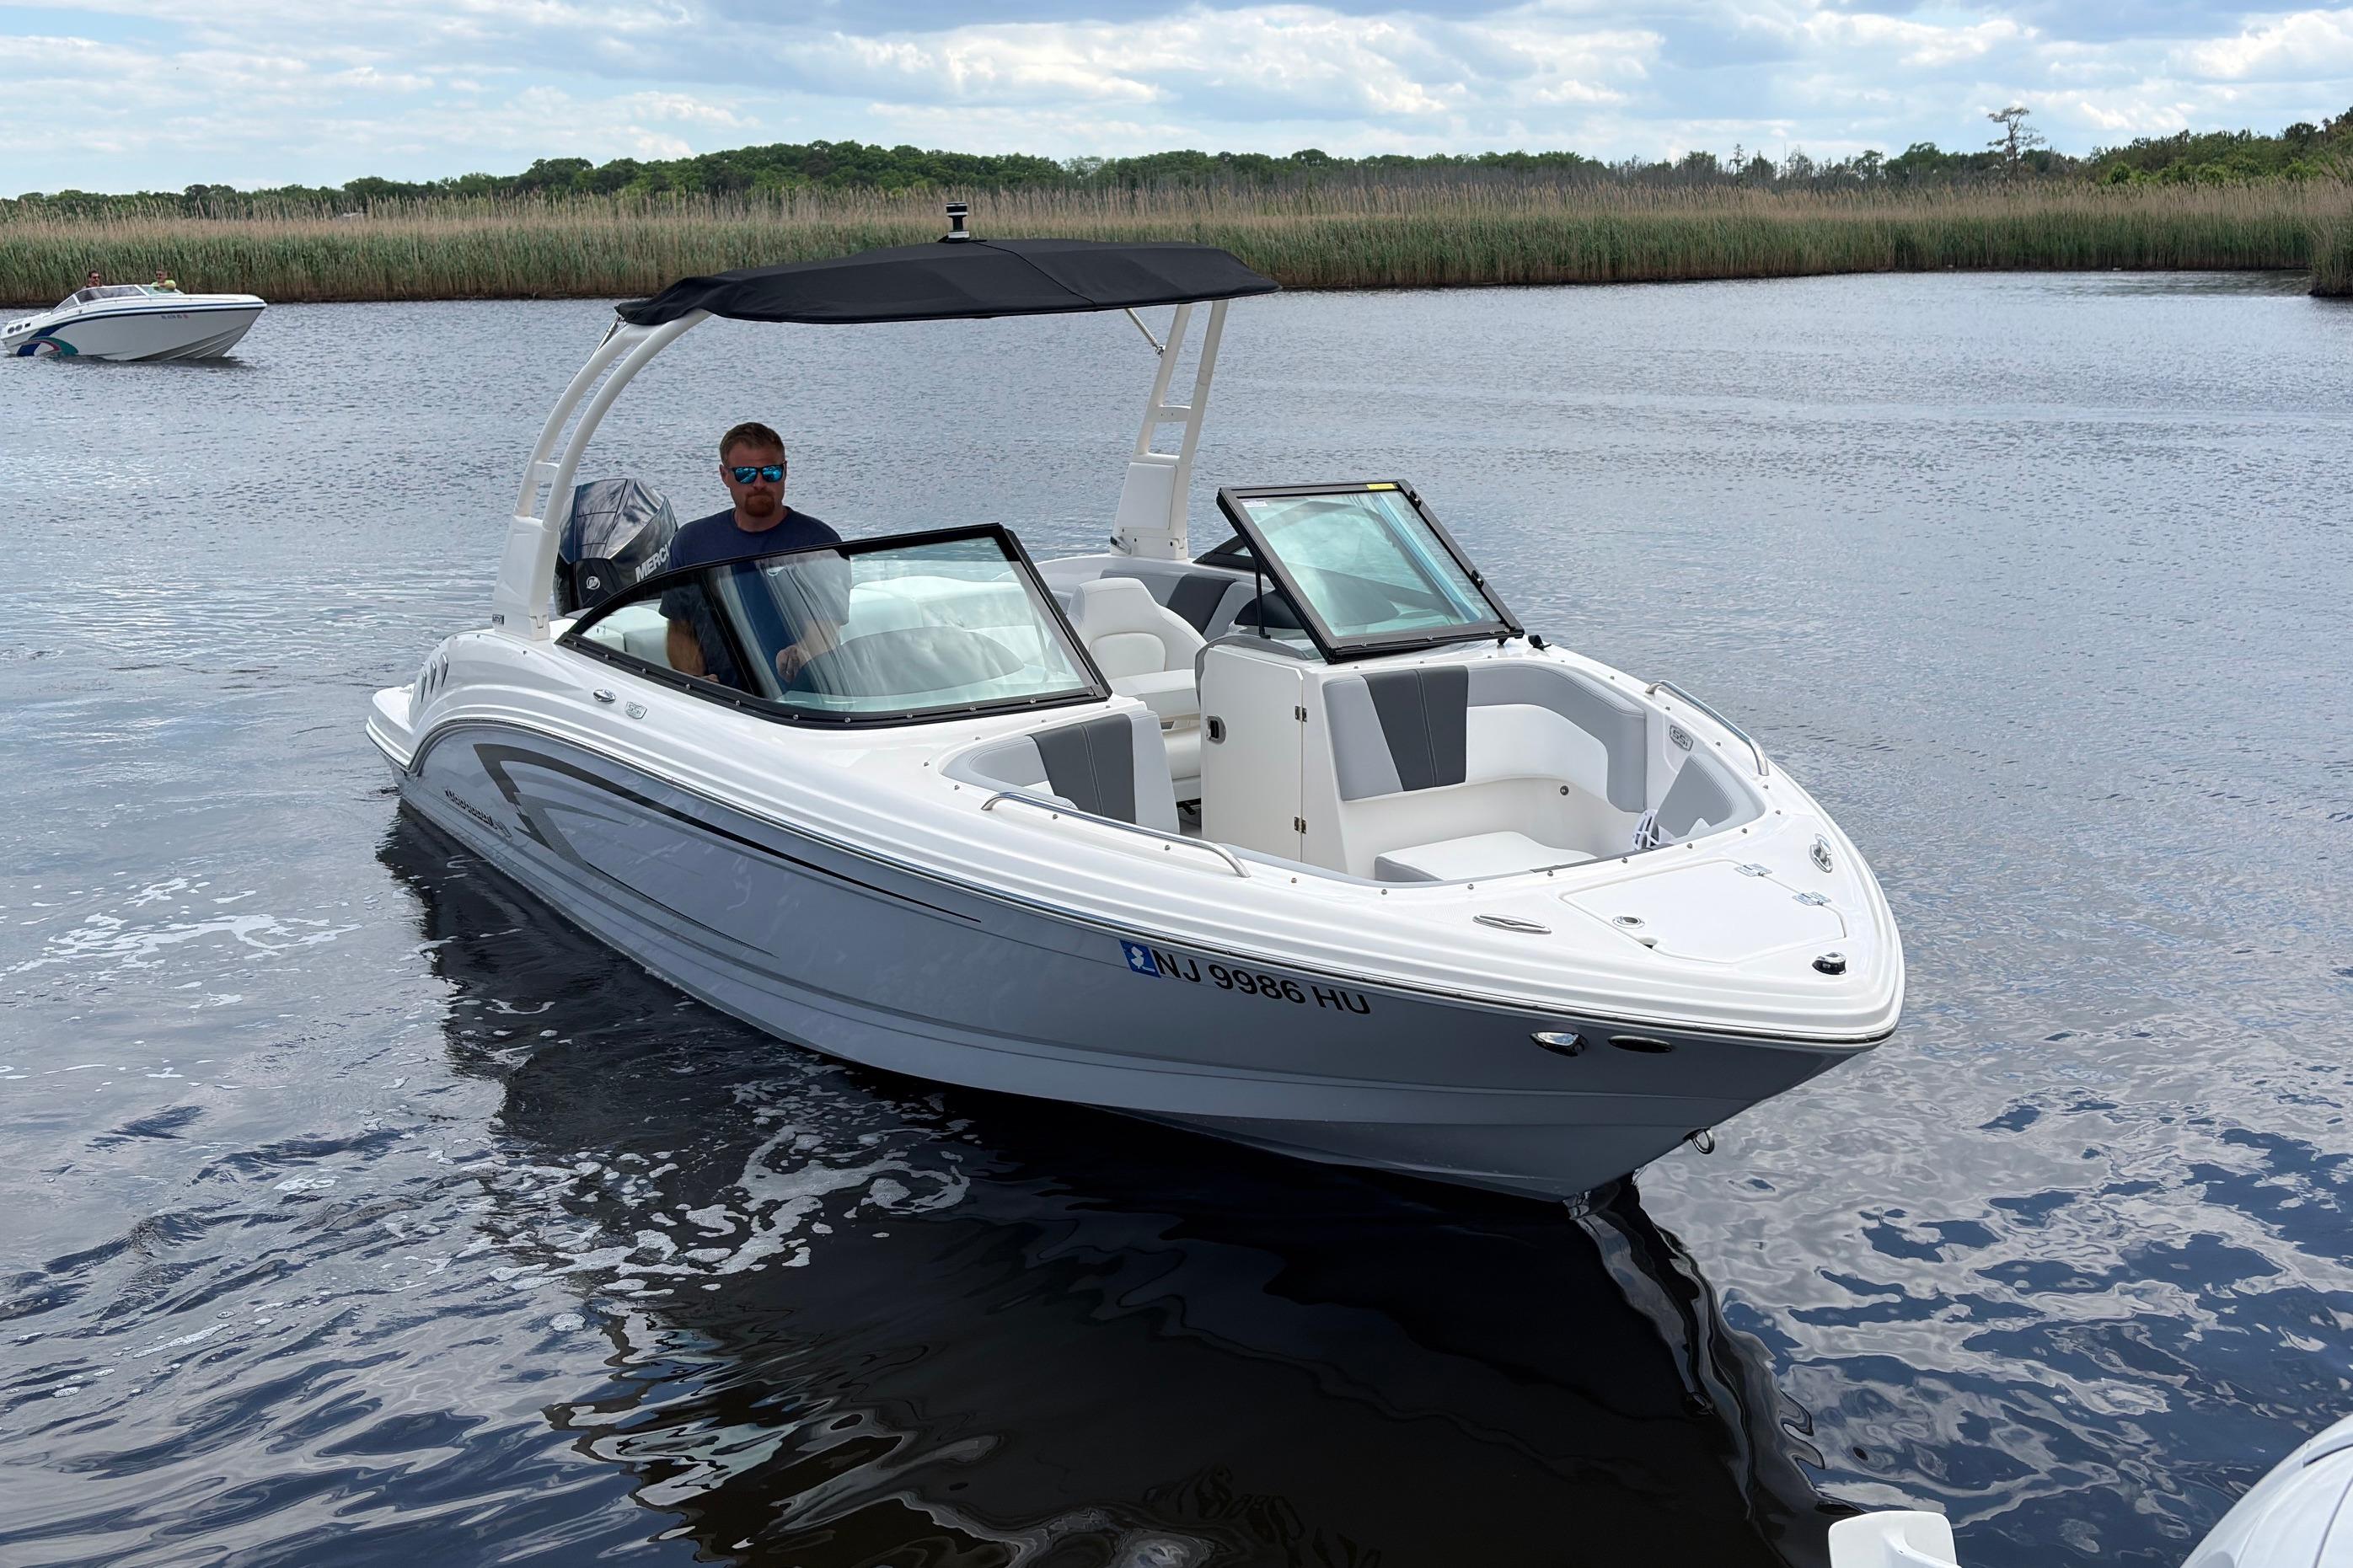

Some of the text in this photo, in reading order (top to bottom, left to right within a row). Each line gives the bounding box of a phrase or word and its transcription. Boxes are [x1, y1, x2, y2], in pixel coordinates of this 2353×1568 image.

[635, 540, 673, 584] MERCU
[1150, 949, 1371, 1015] NJ 9986 HU
